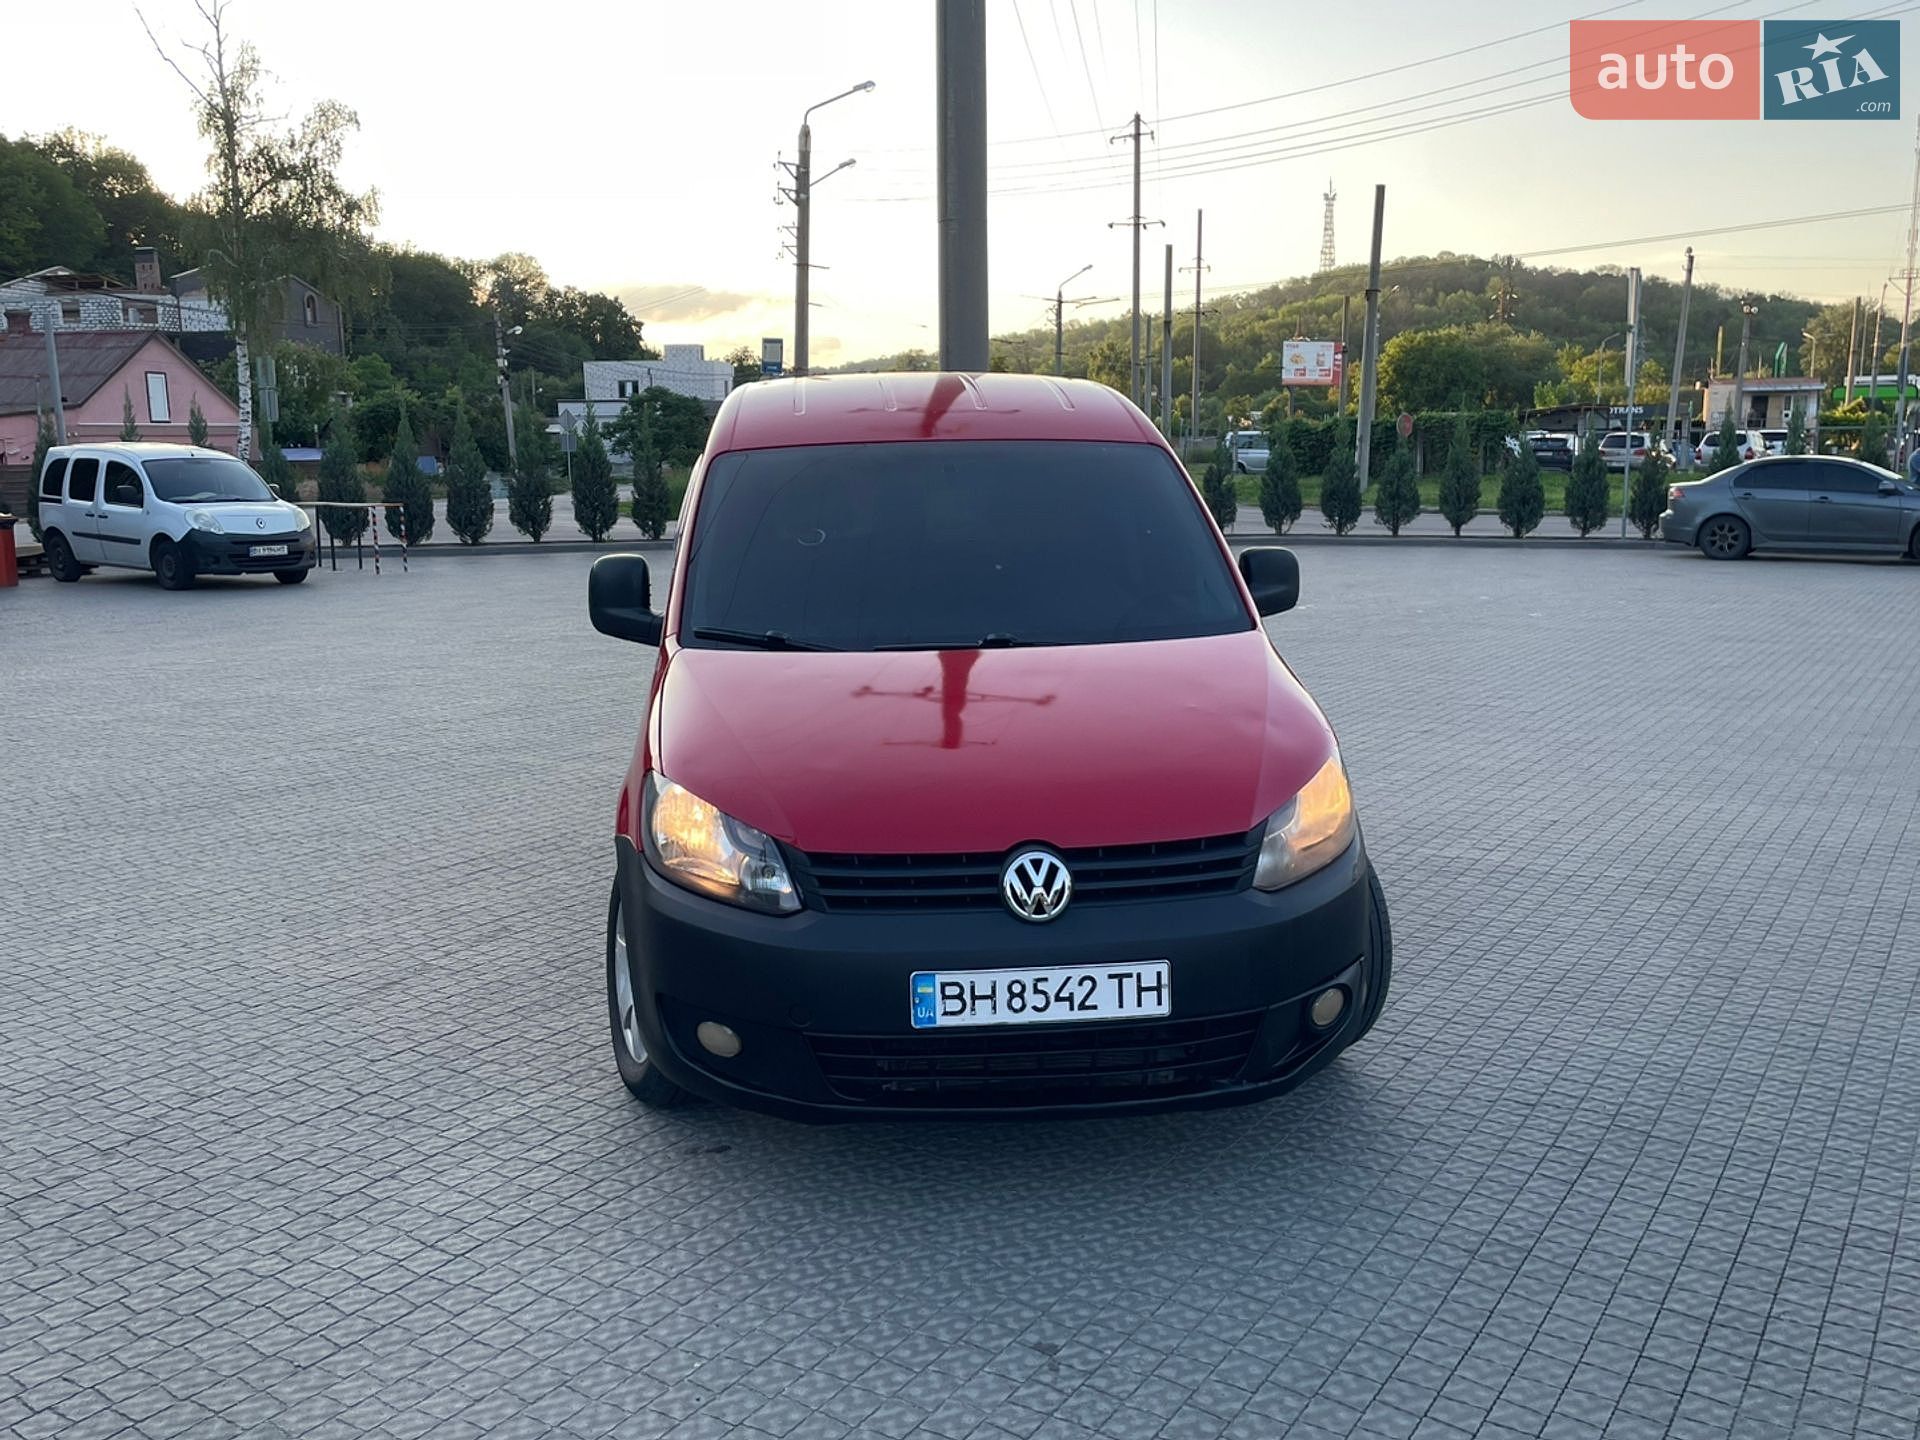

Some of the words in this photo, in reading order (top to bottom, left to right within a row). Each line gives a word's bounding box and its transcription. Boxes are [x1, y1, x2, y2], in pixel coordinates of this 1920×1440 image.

[940, 980, 997, 1017] BH
[1006, 974, 1098, 1014] 8542
[1107, 971, 1163, 1009] TH
[917, 1008, 935, 1018] UA
